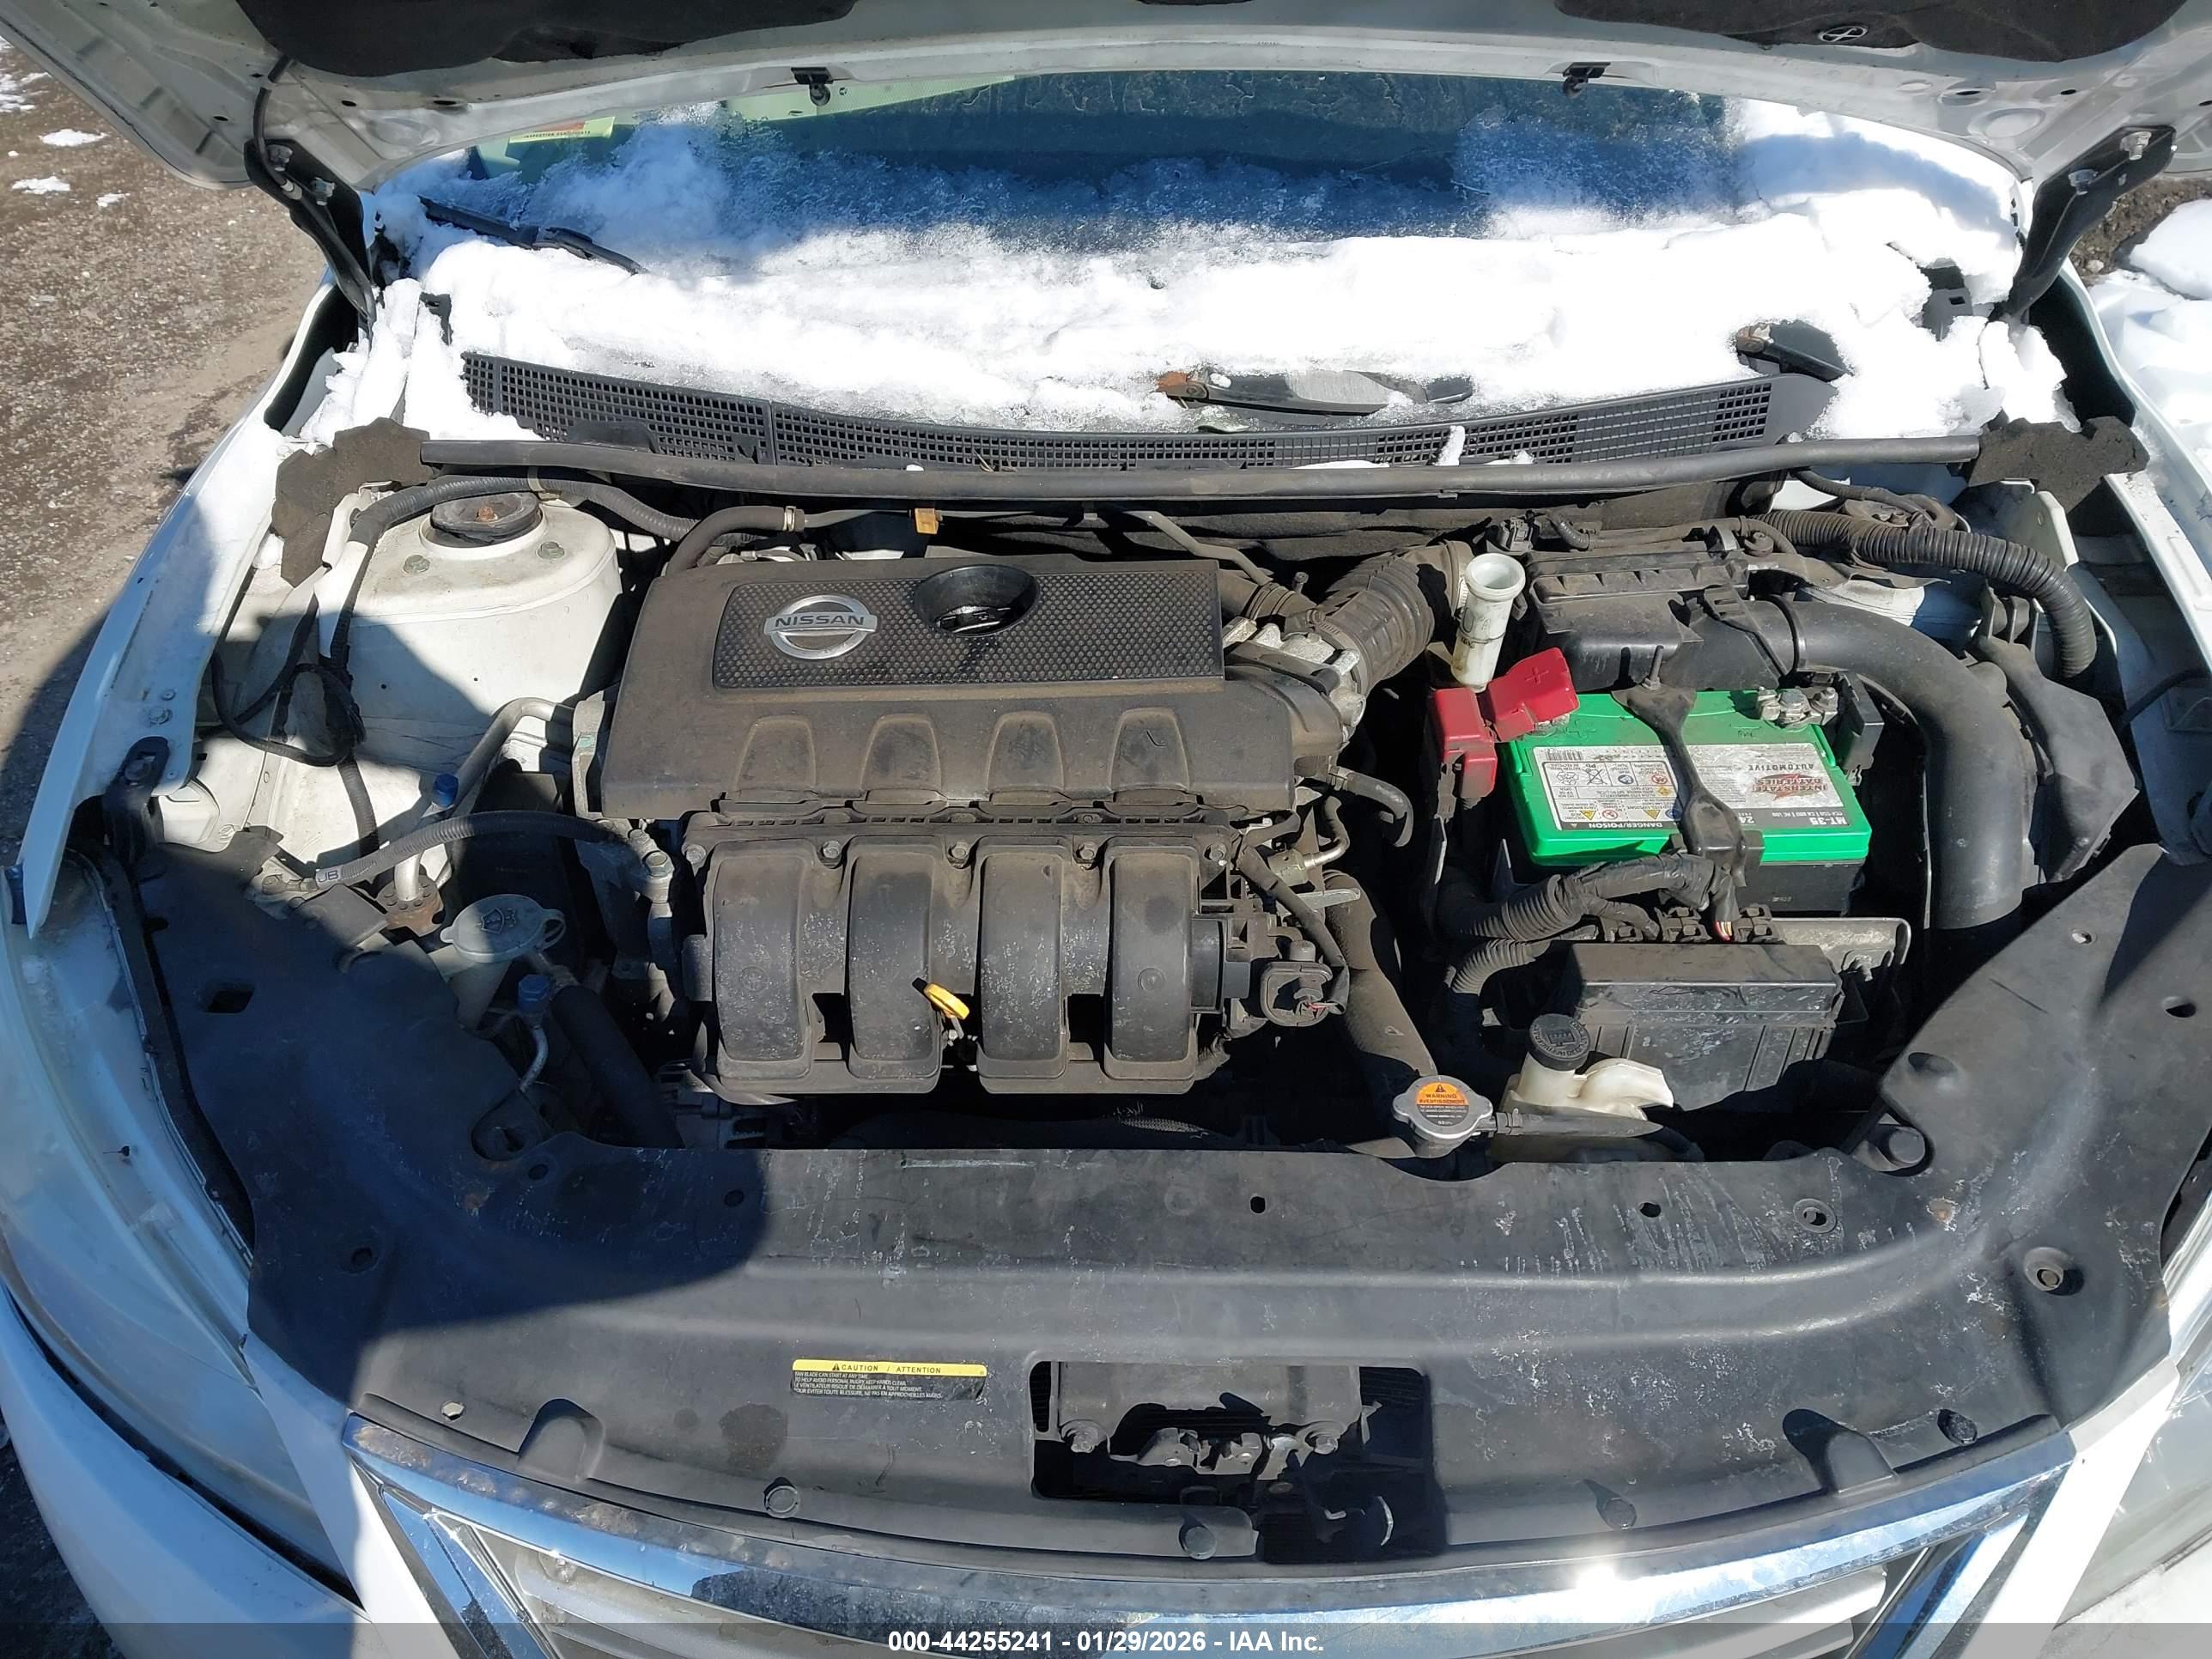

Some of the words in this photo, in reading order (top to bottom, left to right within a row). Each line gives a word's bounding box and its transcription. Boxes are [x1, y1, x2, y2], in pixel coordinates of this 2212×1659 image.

[775, 615, 864, 628] NISSAN
[1739, 817, 1754, 825] 24
[1809, 817, 1847, 825] MT-35
[318, 870, 338, 883] JB
[896, 1365, 941, 1374] ATTENTION
